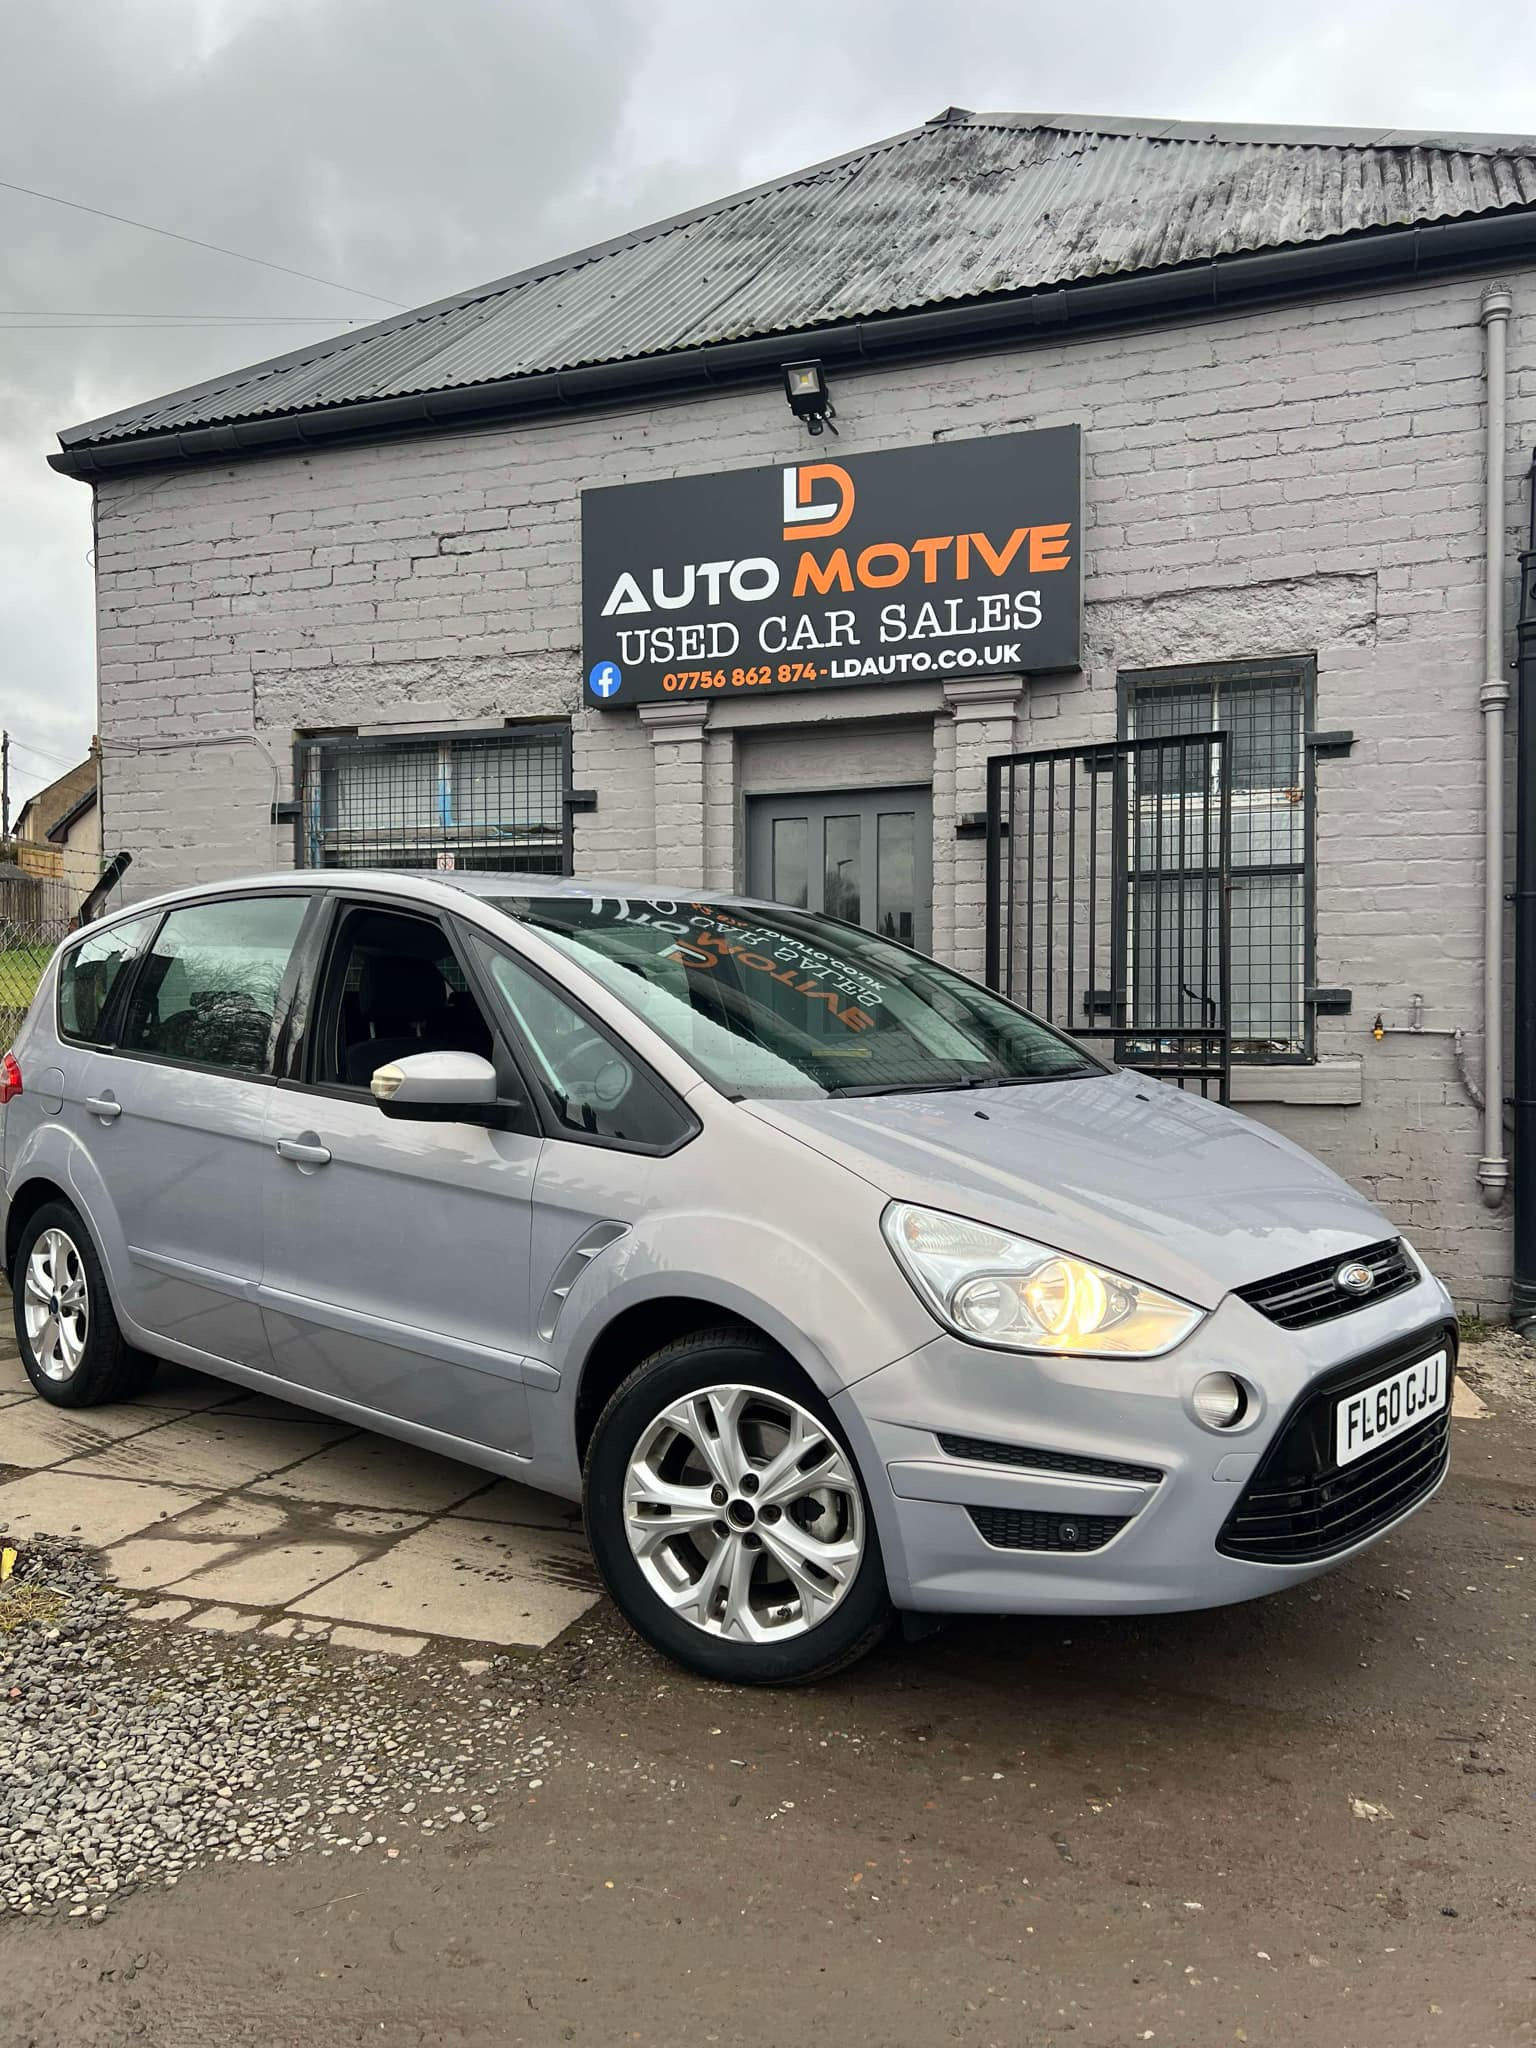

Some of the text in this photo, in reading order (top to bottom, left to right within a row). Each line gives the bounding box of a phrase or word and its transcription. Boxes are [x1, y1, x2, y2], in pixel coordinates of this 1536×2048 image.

[783, 463, 855, 541] LD
[600, 522, 1072, 616] AUTO MOTIVE
[616, 590, 1043, 666] USED CAR SALES
[662, 669, 726, 692] 07756
[731, 666, 772, 687] 862
[831, 643, 1022, 679] LDAUTO.CO.UK
[1348, 1360, 1439, 1450] FL60 GJJ
